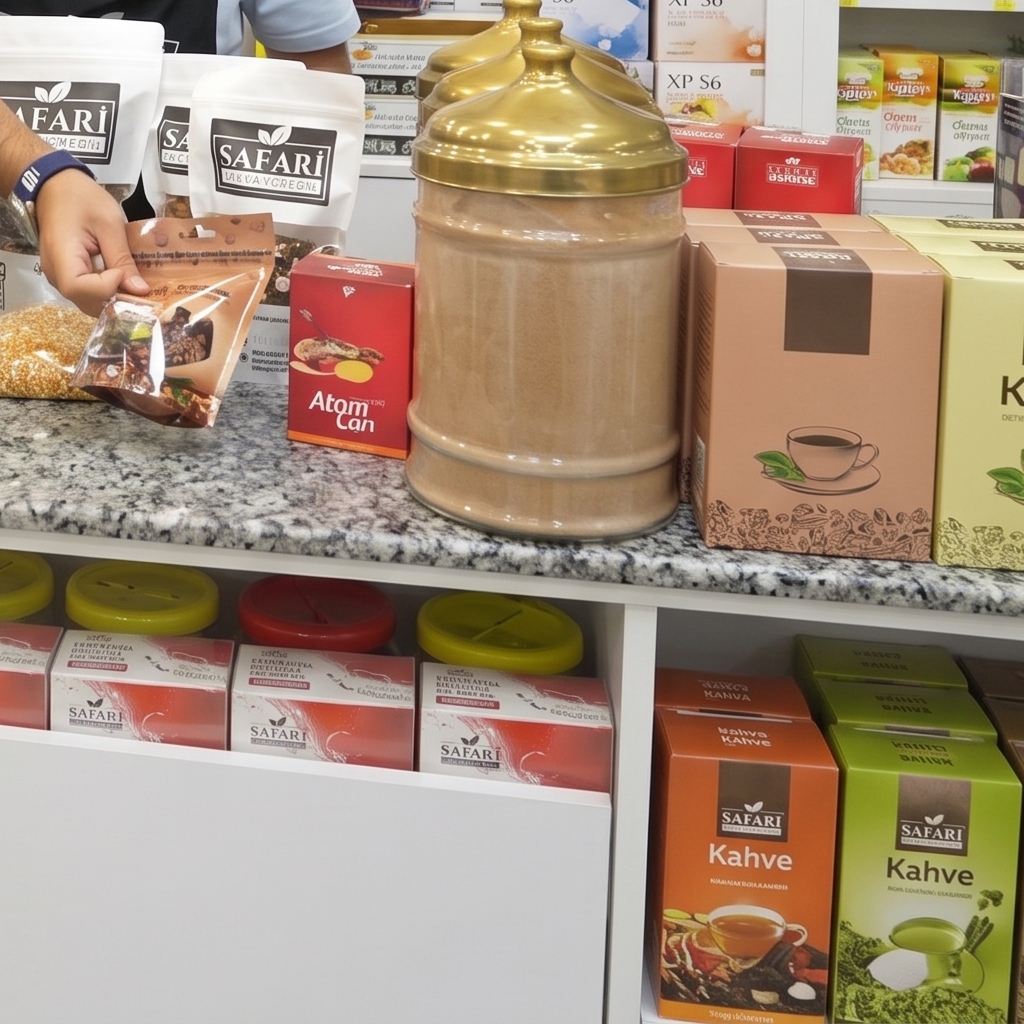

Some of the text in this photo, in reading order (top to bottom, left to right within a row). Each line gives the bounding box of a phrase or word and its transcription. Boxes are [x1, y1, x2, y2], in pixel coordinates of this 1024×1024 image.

[667, 73, 722, 90] XP S6
[15, 105, 108, 135] AFARİ
[308, 390, 369, 418] Atom
[336, 411, 375, 434] Can
[722, 812, 781, 827] SAFARI
[901, 824, 962, 841] SAFARI
[709, 842, 793, 871] Kahve
[887, 856, 974, 886] Kahve
